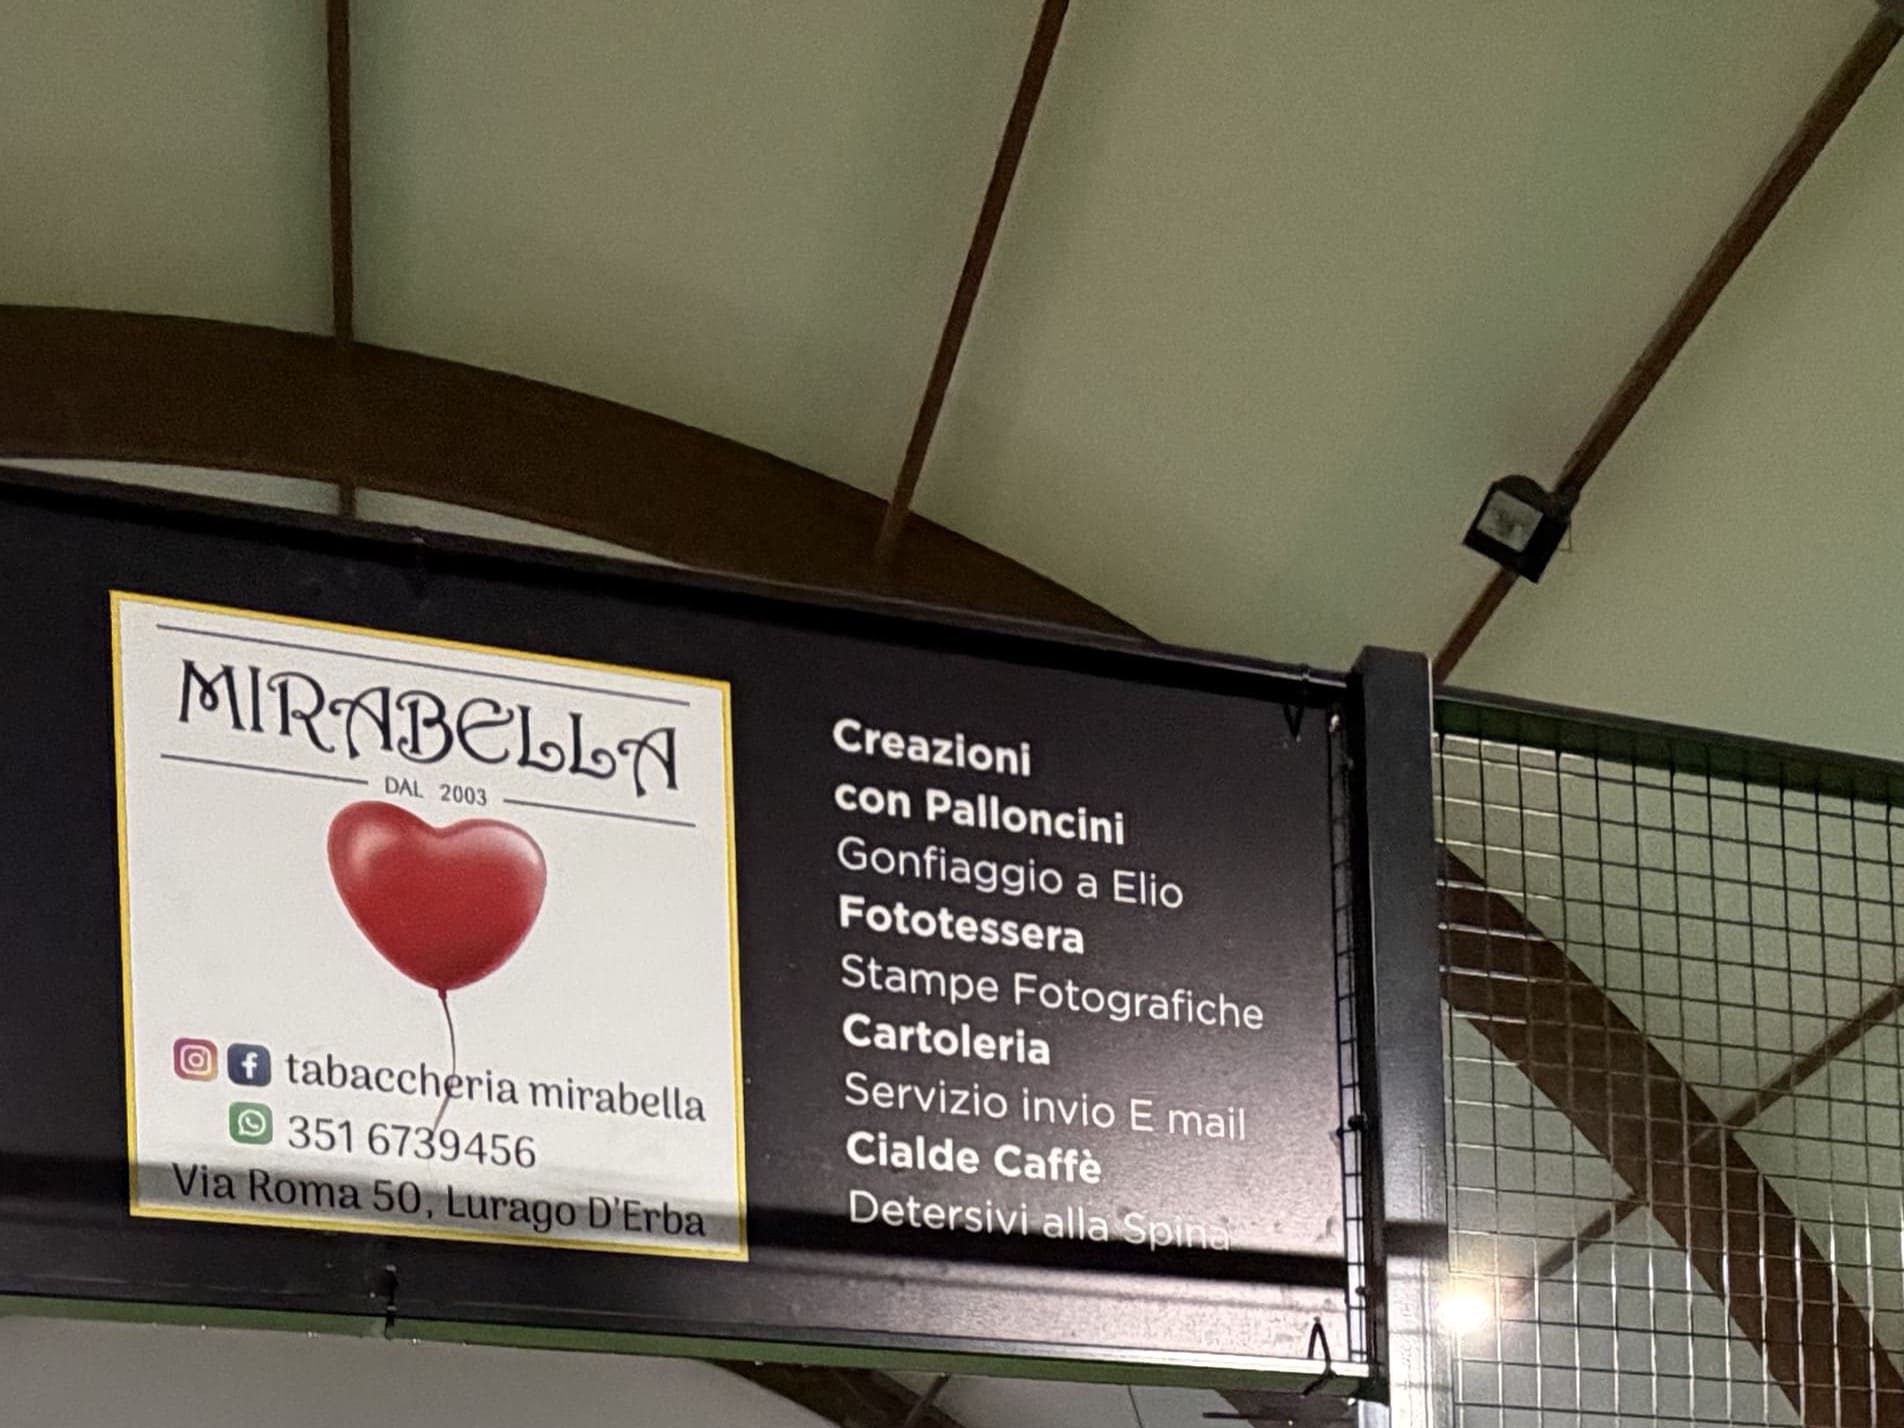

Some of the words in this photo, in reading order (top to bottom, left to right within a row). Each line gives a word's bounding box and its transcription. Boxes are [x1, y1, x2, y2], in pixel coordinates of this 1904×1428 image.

[177, 658, 679, 798] MIRABELLA
[832, 718, 1032, 778] Creazioni
[384, 775, 424, 799] DAL
[439, 783, 488, 807] 2003
[834, 783, 912, 818] con
[926, 788, 1126, 846] Palloncini
[837, 836, 1064, 898] Gonfiaggio
[1076, 870, 1097, 899] a
[1112, 870, 1184, 909] Elio
[839, 895, 1085, 955] Fototessera
[841, 954, 1000, 1006] Stampe
[1014, 972, 1264, 1030] Fotografiche
[842, 1013, 1051, 1066] Cartoleria
[286, 1052, 518, 1106] tabaccheria
[531, 1077, 707, 1122] mirabella
[844, 1072, 1008, 1120] Servizio
[1022, 1088, 1116, 1129] invio
[1130, 1098, 1154, 1133] E
[1167, 1106, 1246, 1141] mail
[287, 1114, 354, 1153] 351
[367, 1121, 537, 1171] 6739456
[846, 1131, 980, 1174] Cialde
[994, 1143, 1102, 1186] Caffè
[172, 1162, 235, 1202] Via
[249, 1168, 360, 1211] Roma
[373, 1179, 434, 1219] 50,
[446, 1184, 577, 1232] Lurago
[588, 1195, 707, 1238] D'Erba
[849, 1189, 1028, 1236] Detersivi
[1042, 1207, 1109, 1243] alla
[1123, 1212, 1231, 1252] Spina
